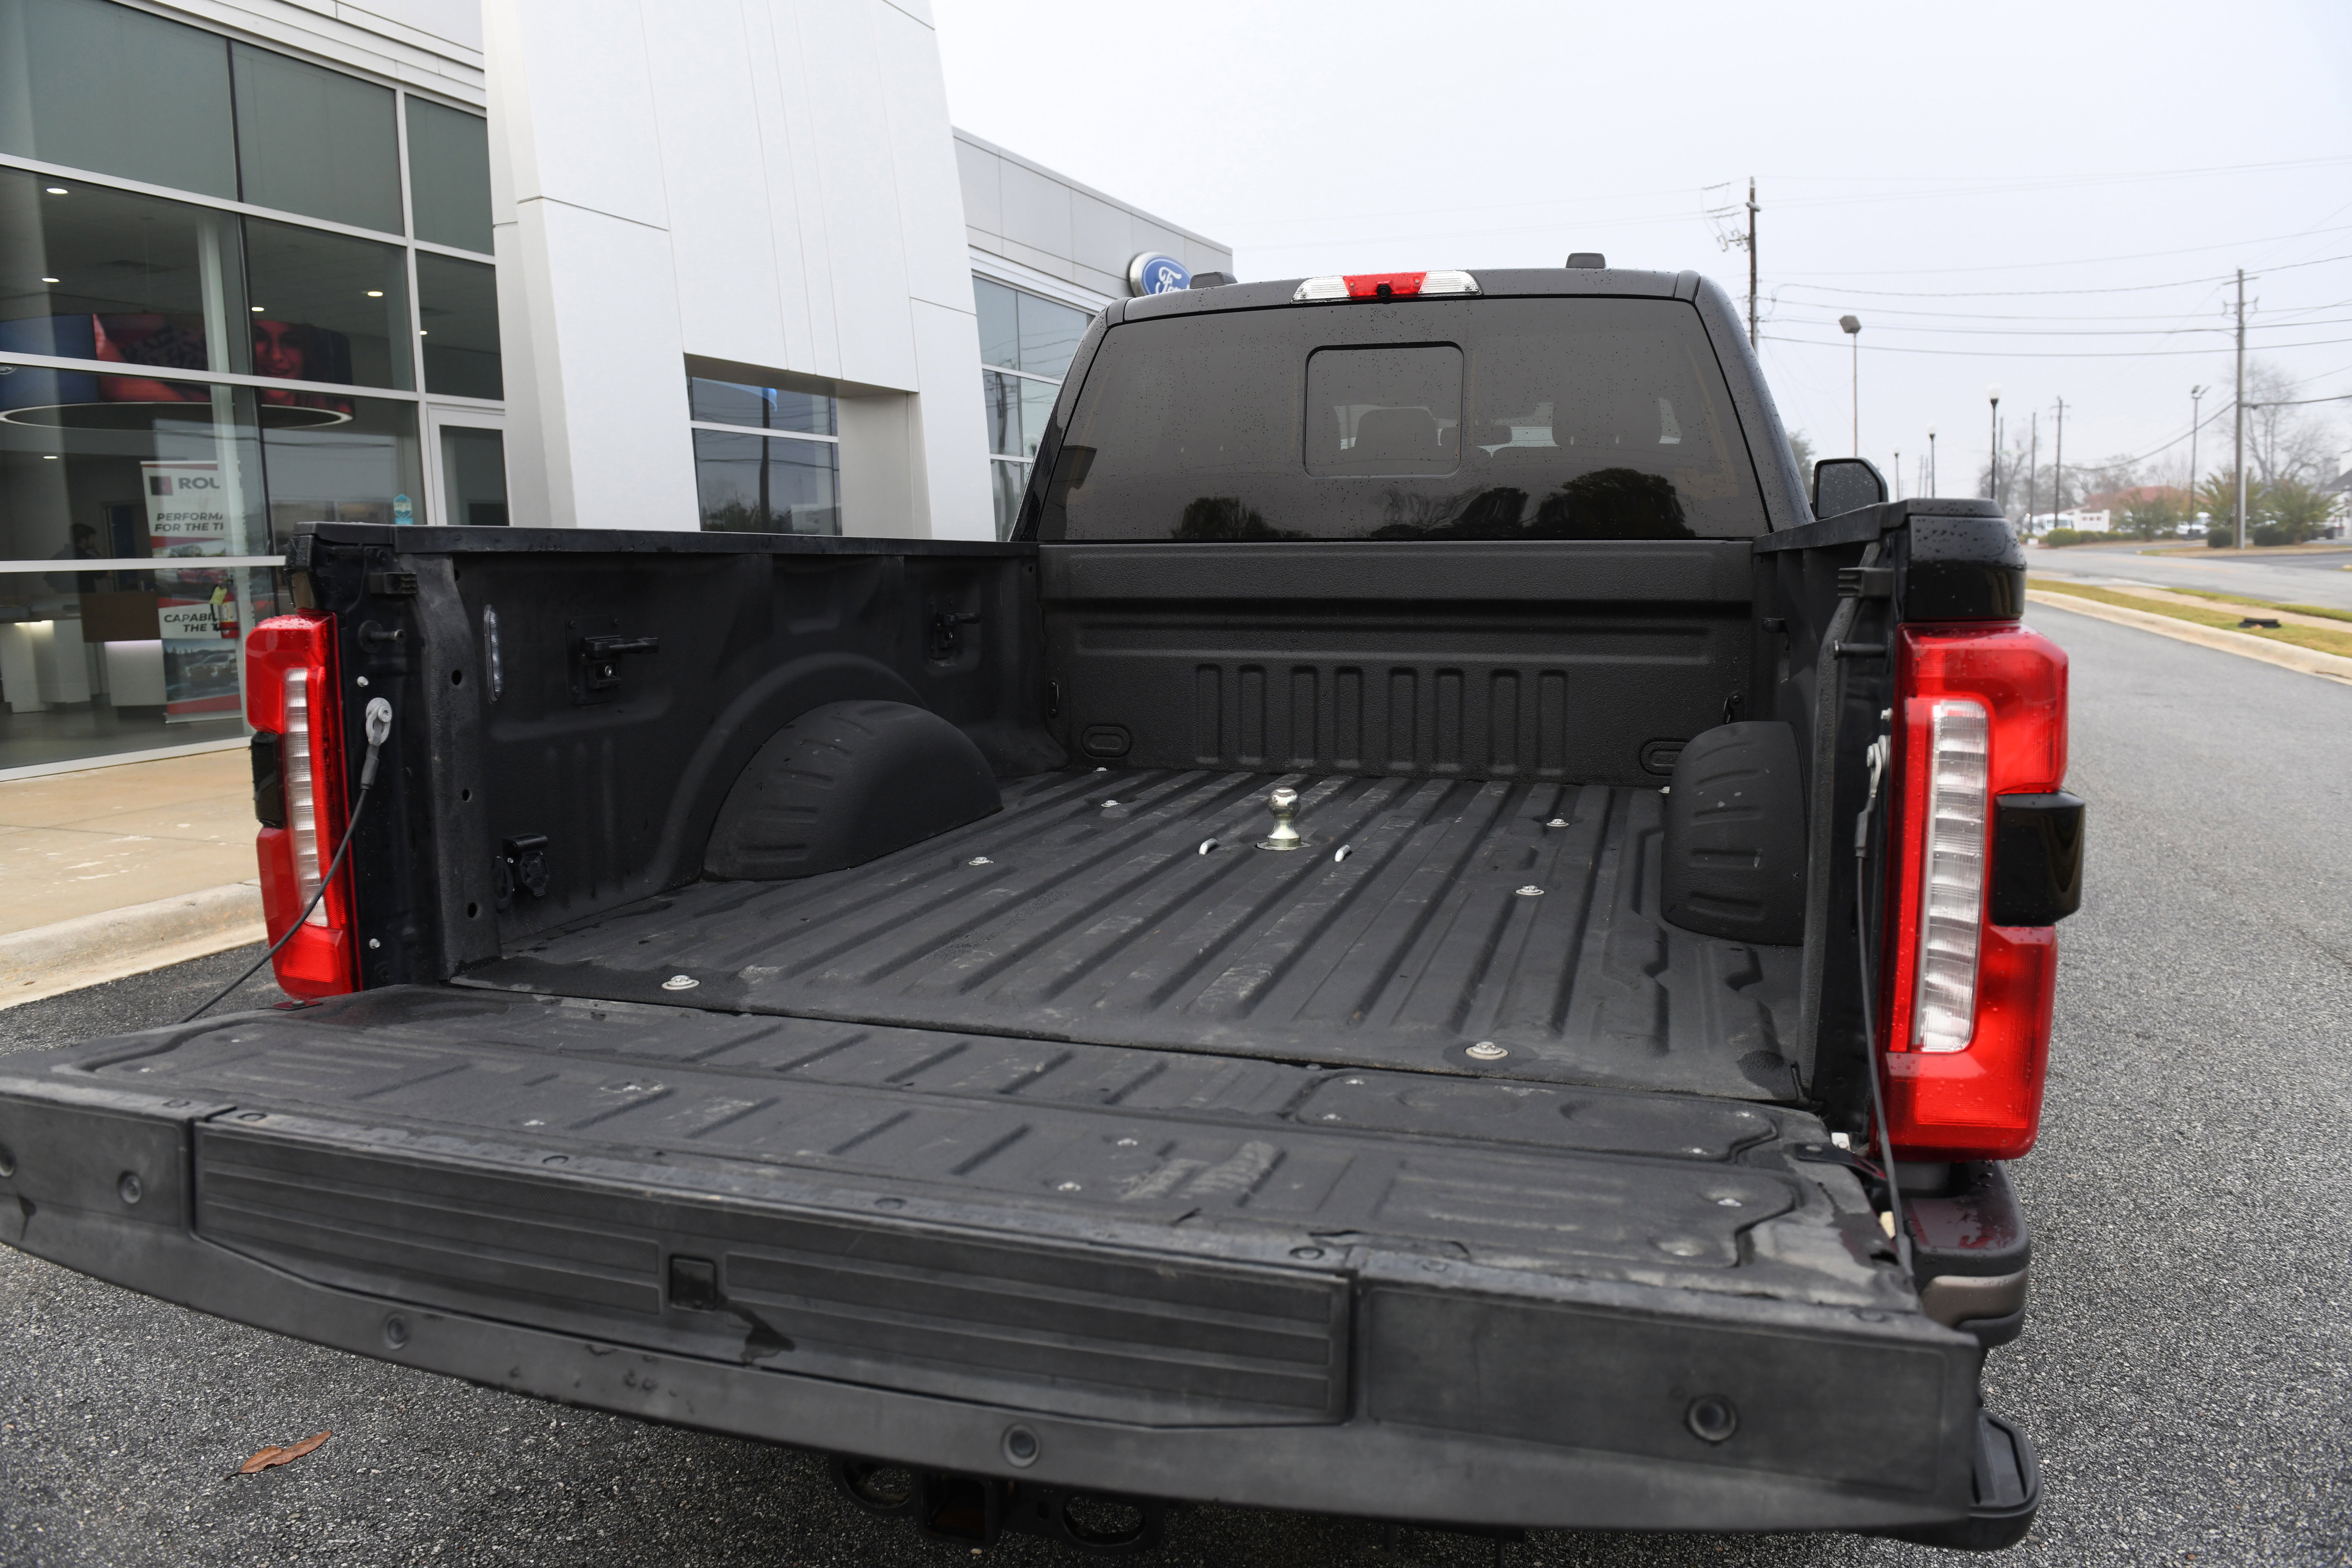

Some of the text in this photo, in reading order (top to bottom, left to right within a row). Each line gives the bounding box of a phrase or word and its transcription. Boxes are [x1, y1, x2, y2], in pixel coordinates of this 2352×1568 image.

[155, 523, 180, 532] FOR
[185, 523, 209, 531] THE
[183, 624, 207, 632] THE
